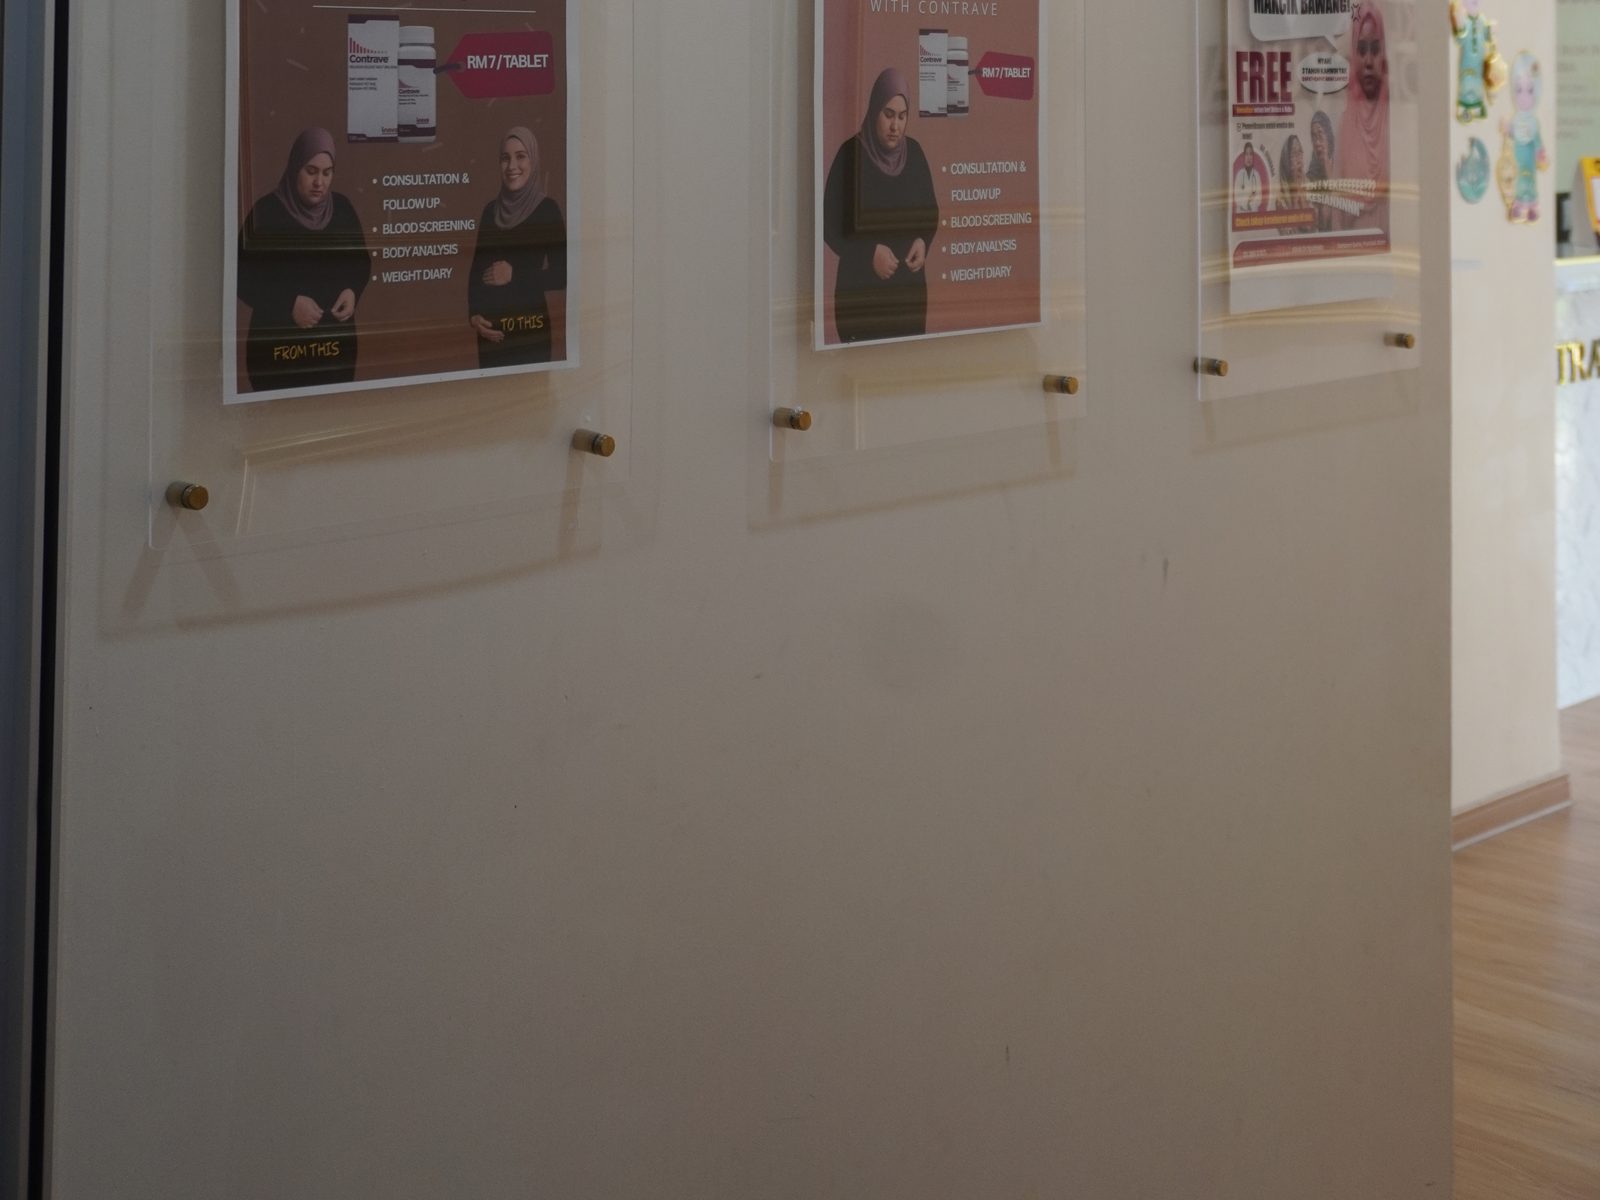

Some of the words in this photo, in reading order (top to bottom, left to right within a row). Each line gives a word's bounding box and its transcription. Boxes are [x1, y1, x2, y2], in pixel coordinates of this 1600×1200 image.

[871, 0, 909, 13] WITH
[918, 1, 998, 16] CONTRAVE
[350, 54, 389, 63] Contrave
[1236, 51, 1292, 103] FREE
[951, 161, 1017, 174] CONSULTATION
[1020, 161, 1026, 172] &
[382, 174, 460, 186] CONSULTATION
[462, 173, 470, 184] &
[952, 189, 989, 201] FOLLOW
[989, 188, 1000, 199] UP
[383, 199, 425, 210] FOLLOW
[425, 197, 440, 209] UP
[382, 222, 418, 234] BLOOD
[419, 219, 475, 233] SCREENING
[951, 216, 983, 228] BLOOD
[983, 213, 1032, 226] SCREENING
[382, 247, 412, 259] BODY
[412, 244, 458, 257] ANALYSIS
[951, 242, 976, 254] BODY
[976, 240, 1016, 252] ANALYSIS
[382, 270, 423, 283] WEIGHT
[423, 268, 452, 280] DIARY
[951, 268, 986, 282] WEIGHT
[986, 266, 1011, 278] DIARY
[501, 317, 515, 332] TO
[517, 315, 544, 329] THIS
[274, 343, 307, 361] FROM
[309, 341, 340, 357] THIS
